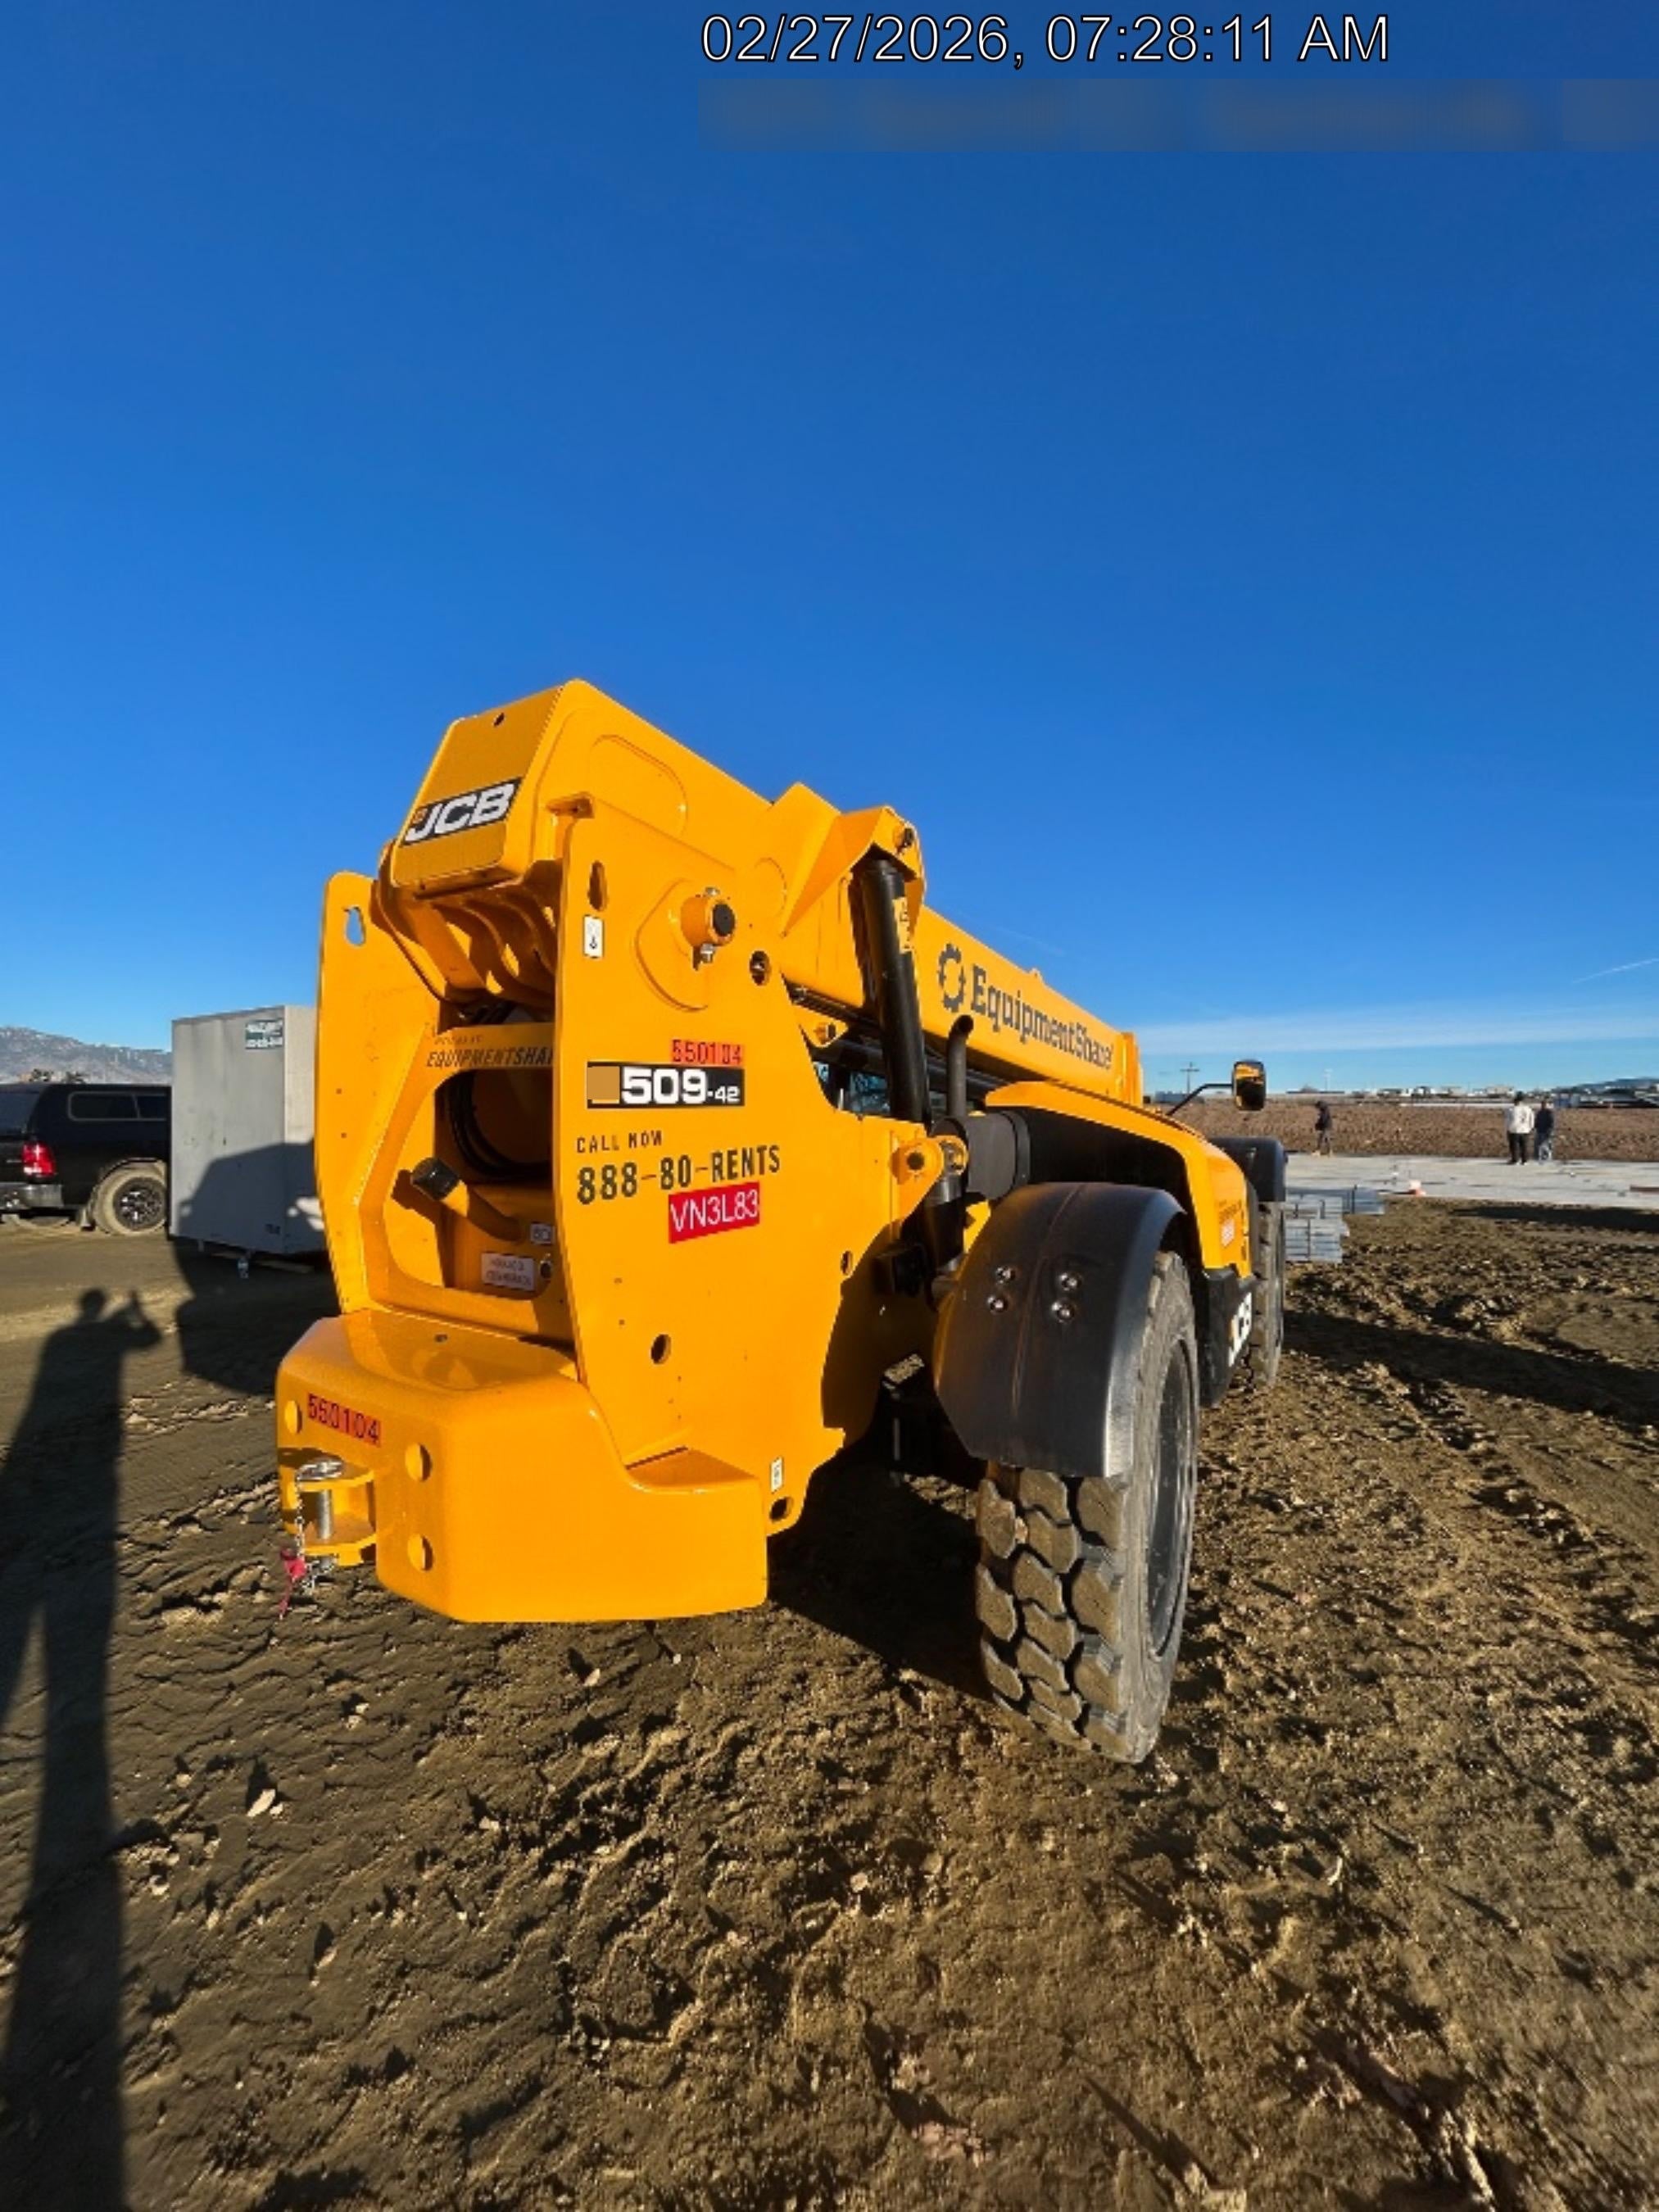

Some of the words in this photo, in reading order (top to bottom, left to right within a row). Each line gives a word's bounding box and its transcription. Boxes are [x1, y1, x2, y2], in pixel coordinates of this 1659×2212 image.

[405, 782, 515, 842] JCB
[672, 1039, 743, 1064] 550104
[576, 1135, 619, 1154] CALL
[628, 1130, 663, 1149] NOW
[577, 1145, 781, 1205] 888-80-RENTS
[669, 1188, 759, 1233] VN3L83
[307, 1393, 380, 1445] 550104
